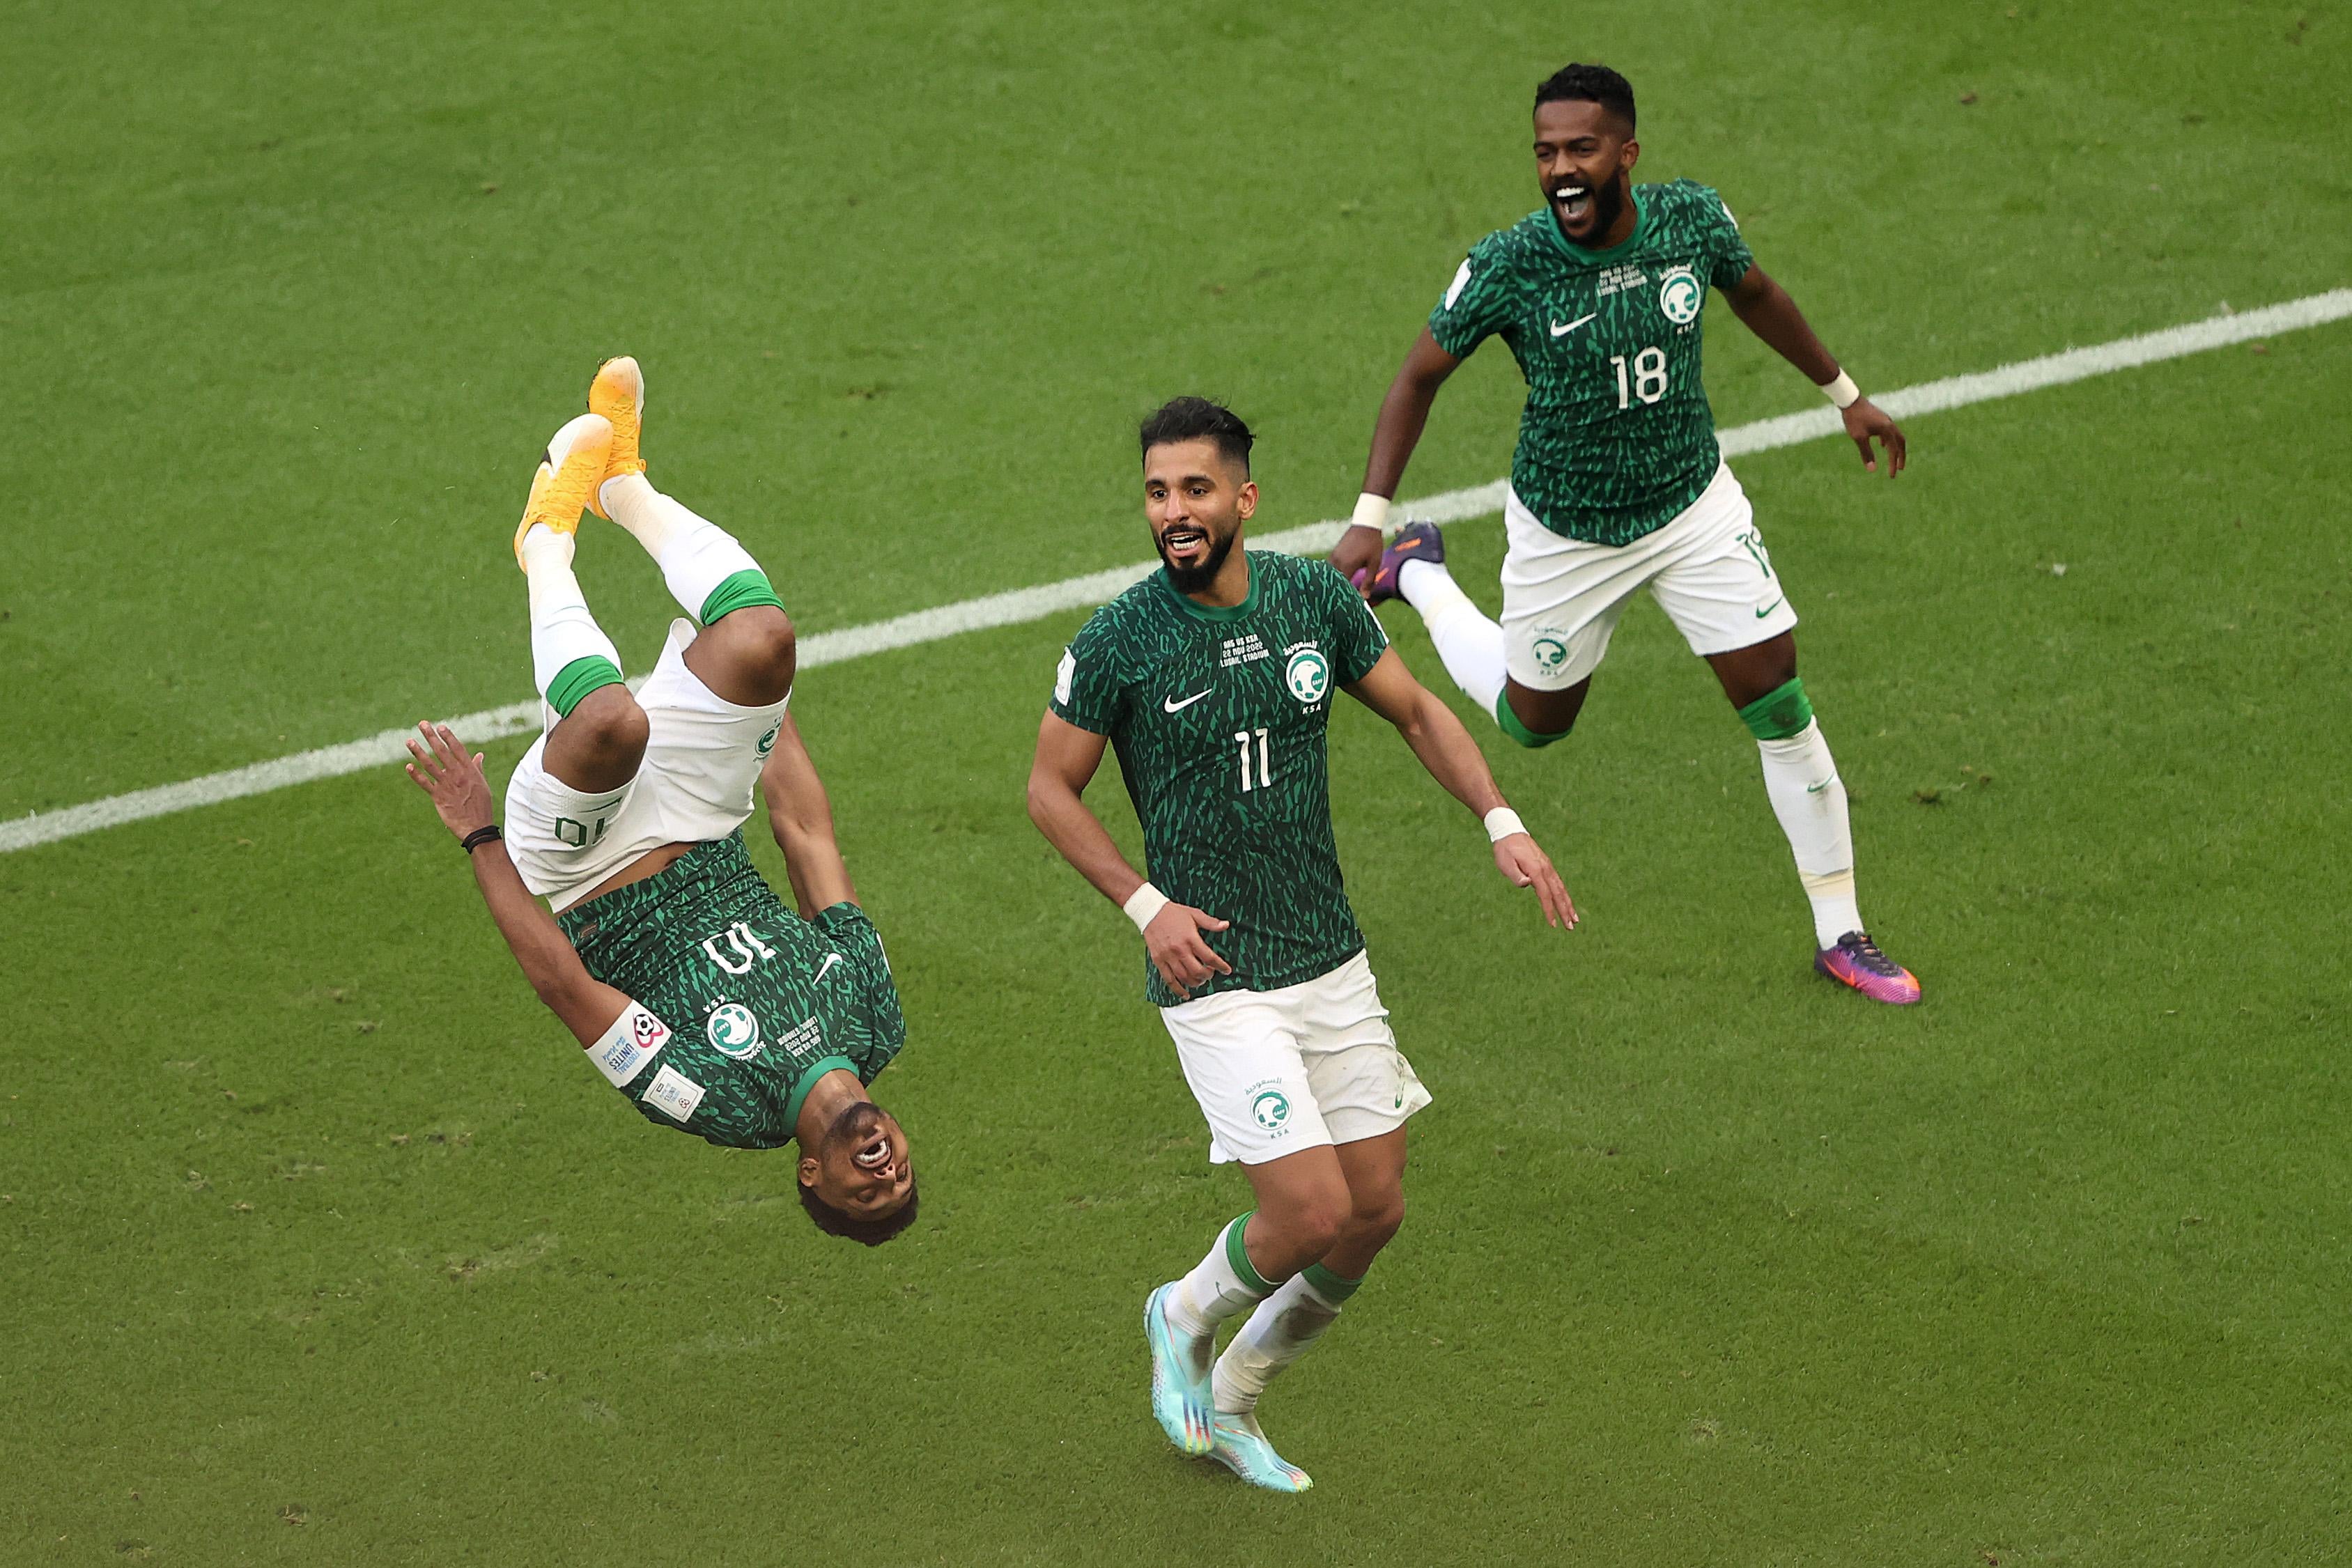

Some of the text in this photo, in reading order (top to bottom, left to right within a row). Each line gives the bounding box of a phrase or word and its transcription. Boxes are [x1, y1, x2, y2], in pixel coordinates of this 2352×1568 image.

[1610, 346, 1666, 409] 18
[1223, 639, 1235, 649] ARG
[1246, 634, 1258, 644] KSA
[1223, 642, 1263, 658] 22 NOV 2022
[1220, 649, 1269, 667] LUSAIL STADIUM
[1302, 703, 1322, 715] KSA
[1235, 728, 1271, 791] 11
[702, 922, 777, 975] 10
[703, 994, 725, 1013] KSA
[716, 1022, 729, 1034] SAFF
[784, 1038, 800, 1051] 2022
[609, 1043, 635, 1070] UNITES
[616, 1050, 640, 1075] FOOTBALL
[1244, 1077, 1282, 1095] السعودية
[1271, 1128, 1289, 1139] KSA
